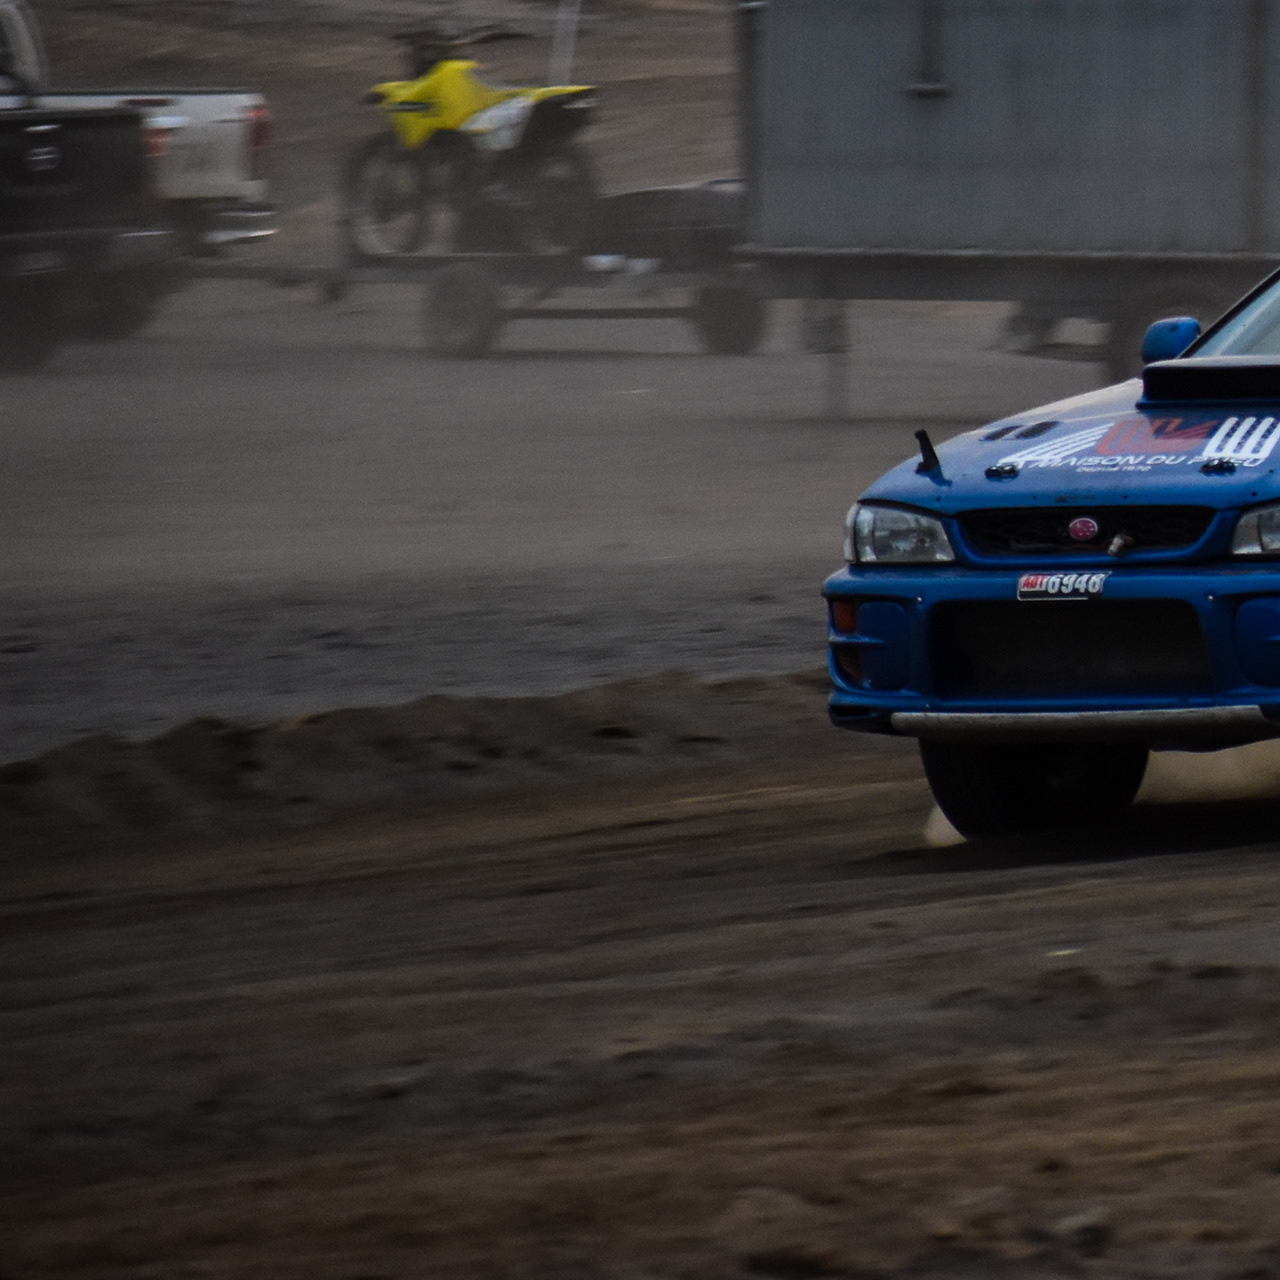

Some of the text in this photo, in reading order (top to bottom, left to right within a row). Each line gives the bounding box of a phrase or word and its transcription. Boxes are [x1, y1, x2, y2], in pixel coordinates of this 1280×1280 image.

[1028, 455, 1145, 469] MAISON
[1147, 455, 1187, 466] DU
[1186, 455, 1266, 468] PEU
